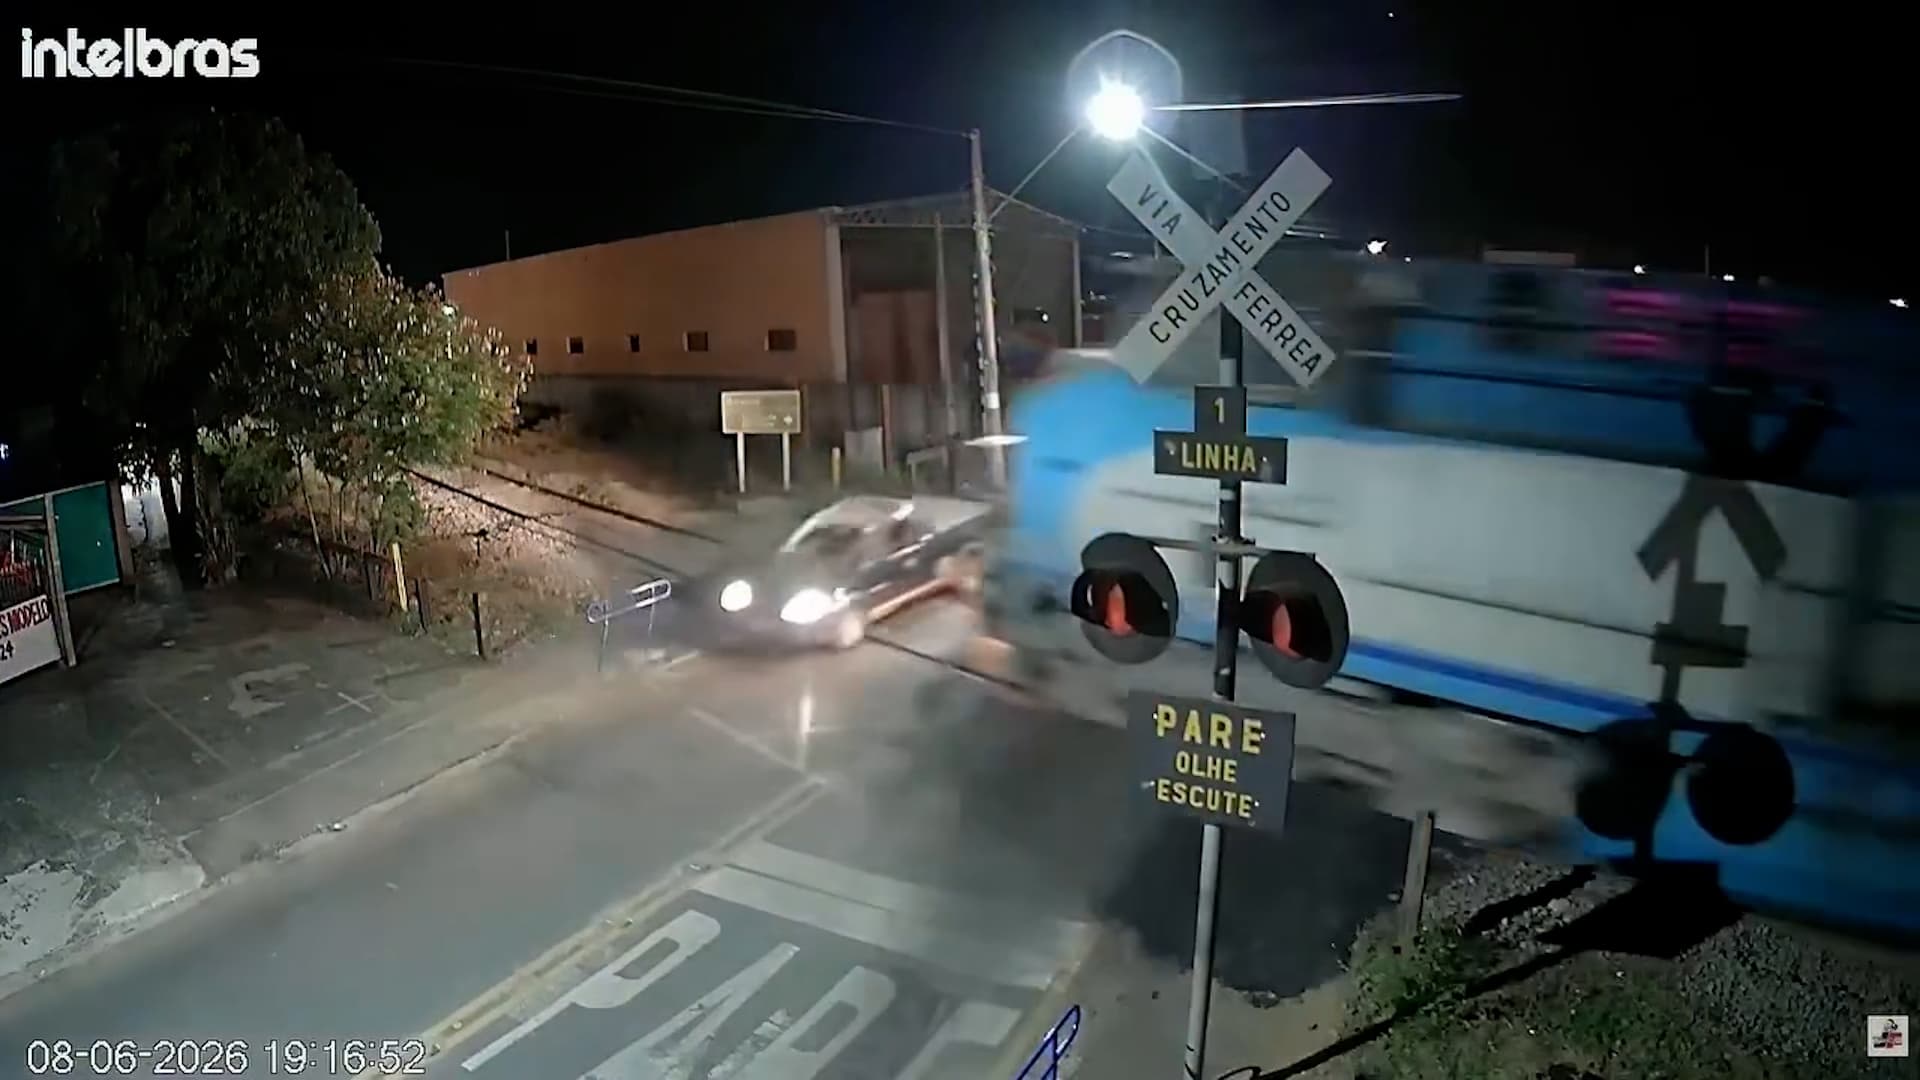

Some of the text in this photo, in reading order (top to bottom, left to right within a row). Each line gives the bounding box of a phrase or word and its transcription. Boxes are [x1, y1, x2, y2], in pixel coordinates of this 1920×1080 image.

[1137, 184, 1322, 376] VIA FERREA
[1149, 191, 1291, 344] CRUZAMENTO
[1213, 397, 1225, 424] 1
[1181, 441, 1257, 473] LINHA
[1156, 703, 1263, 755] PARE
[1175, 750, 1238, 783] OLHE
[1156, 777, 1254, 819] ESCUTE
